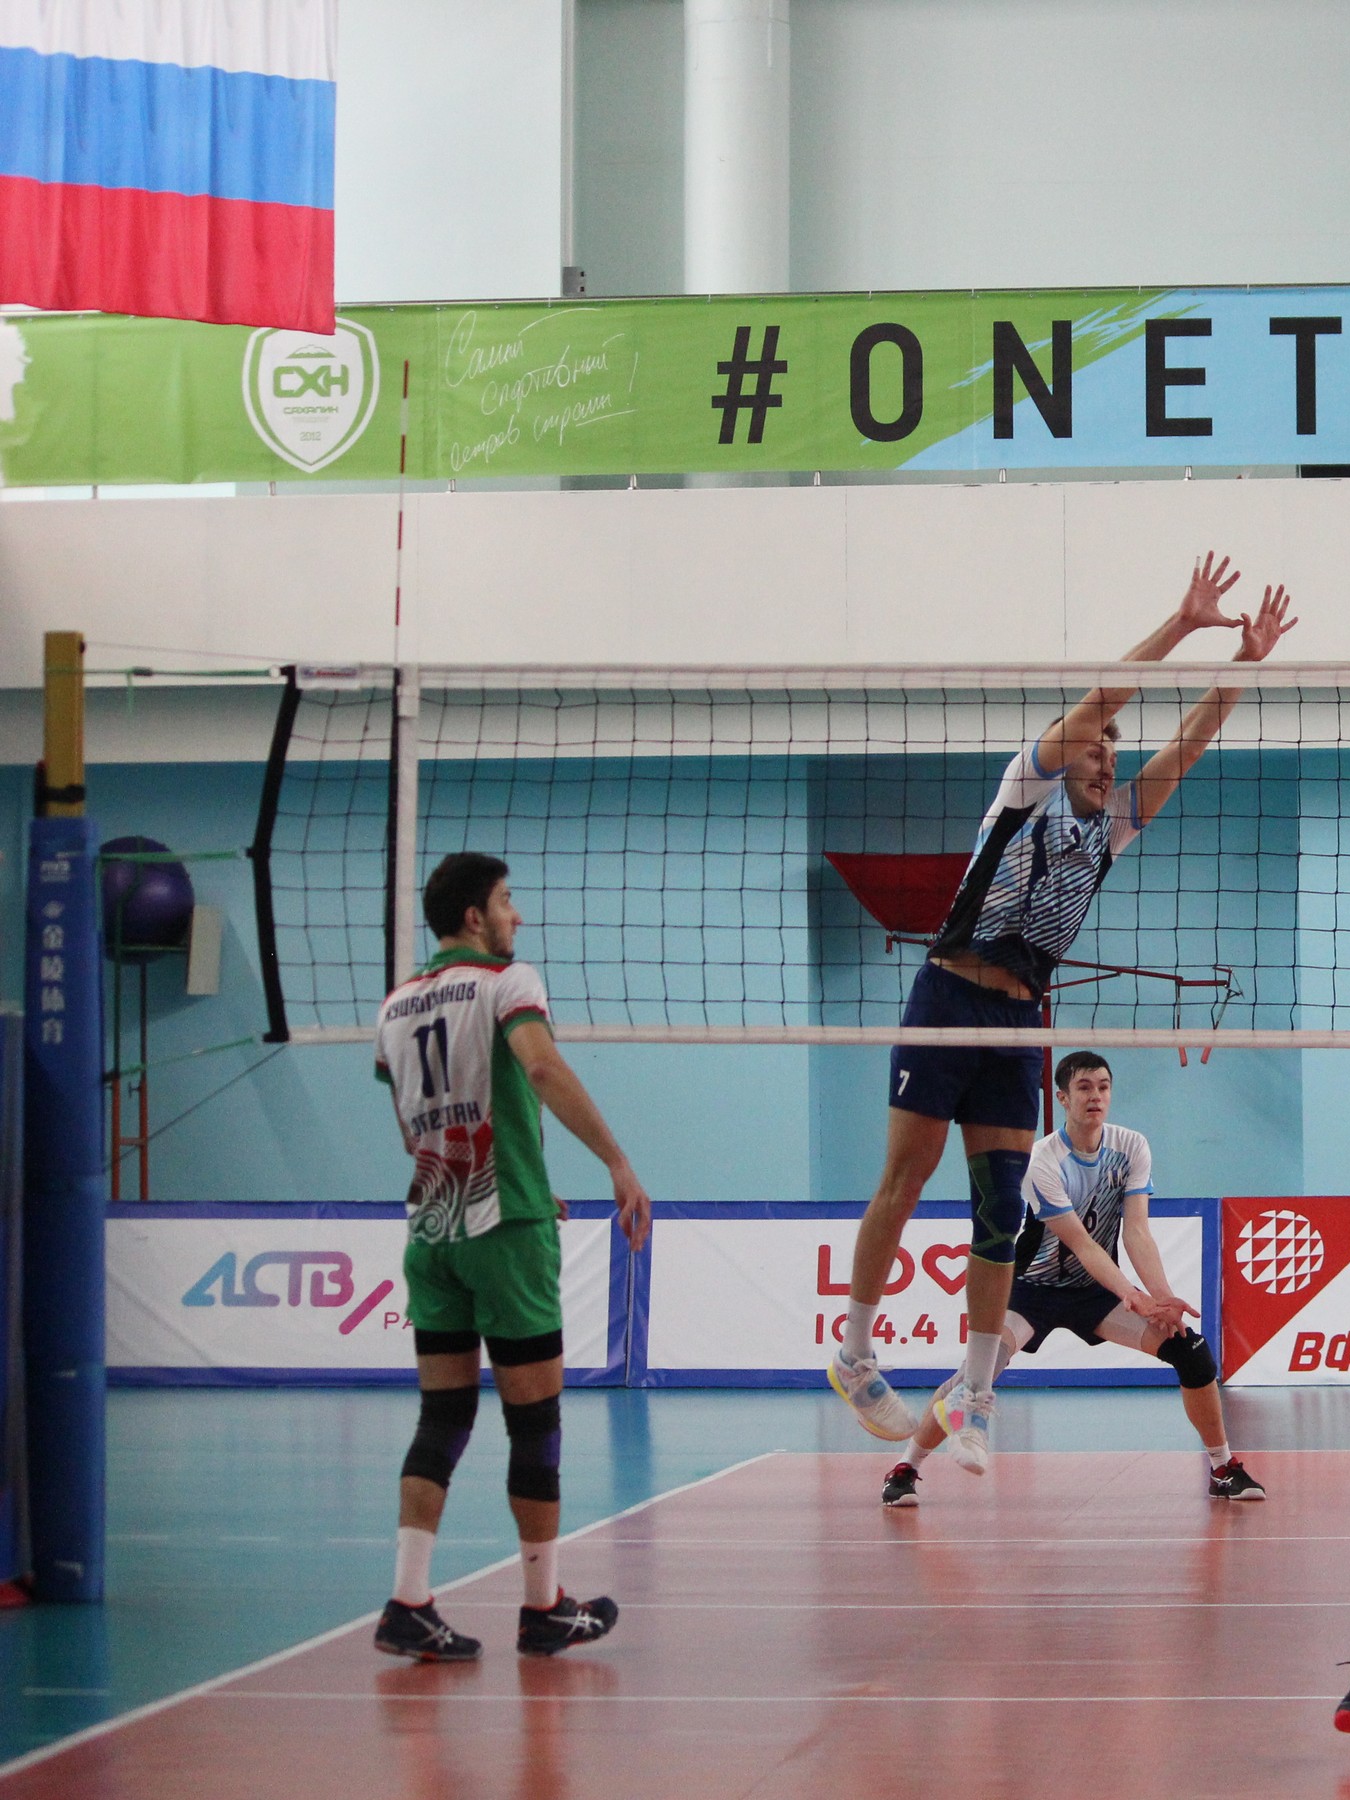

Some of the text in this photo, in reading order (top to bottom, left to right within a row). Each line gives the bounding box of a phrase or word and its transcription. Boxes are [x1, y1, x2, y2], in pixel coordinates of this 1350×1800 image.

[413, 1017, 450, 1098] 11
[897, 1070, 910, 1096] 7
[1084, 1195, 1099, 1235] 6
